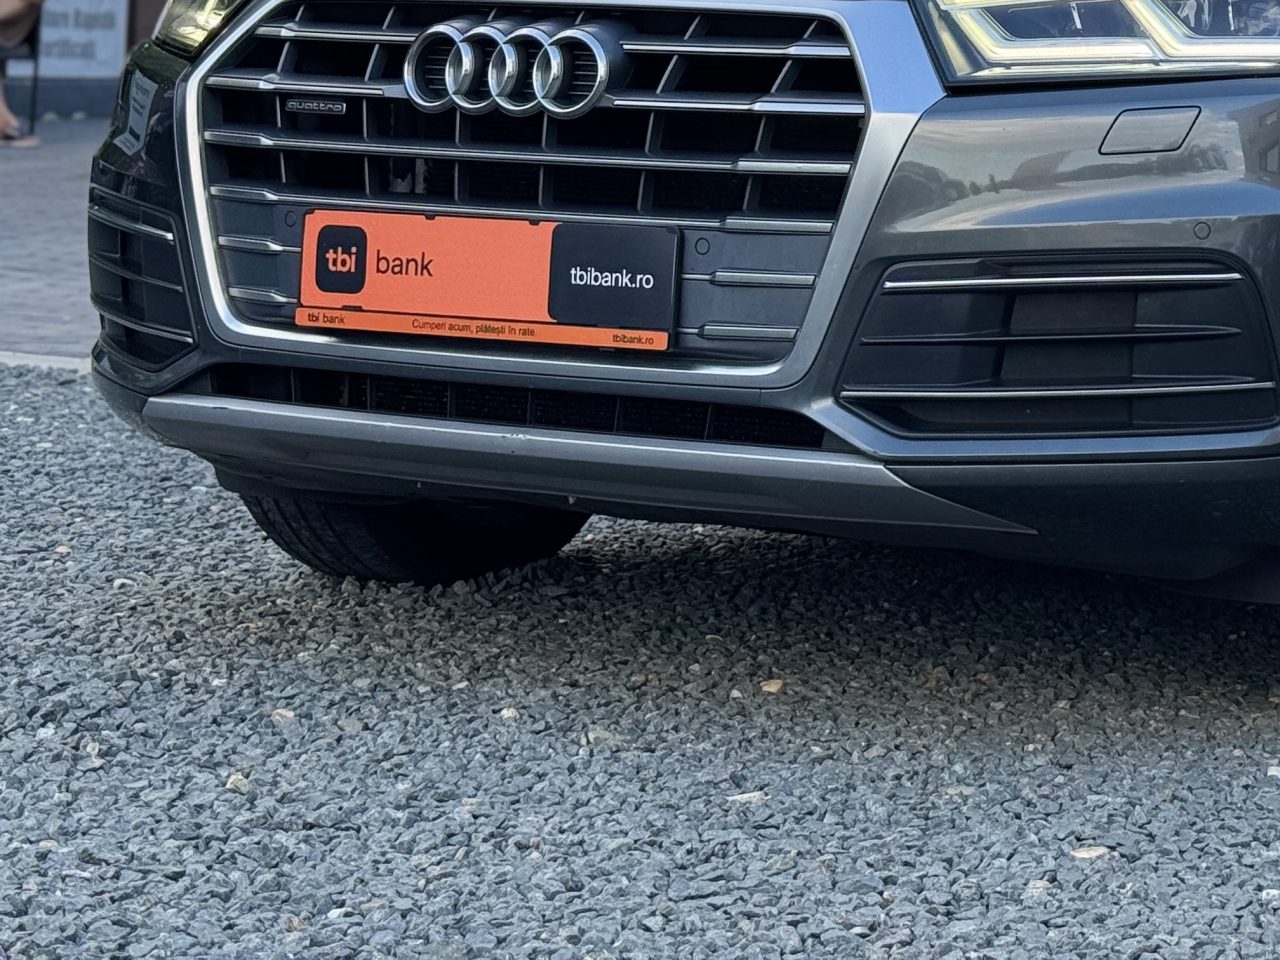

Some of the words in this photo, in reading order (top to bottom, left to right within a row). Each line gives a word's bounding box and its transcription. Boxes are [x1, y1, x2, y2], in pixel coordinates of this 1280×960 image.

[287, 101, 343, 112] quattro
[325, 246, 358, 273] tbi
[375, 249, 434, 277] bank
[570, 266, 655, 289] tbibank.ro
[307, 312, 320, 323] tbi
[322, 314, 346, 325] bank
[411, 318, 447, 331] Cumperi
[518, 327, 536, 337] rate
[612, 333, 655, 346] tbibank.ro
